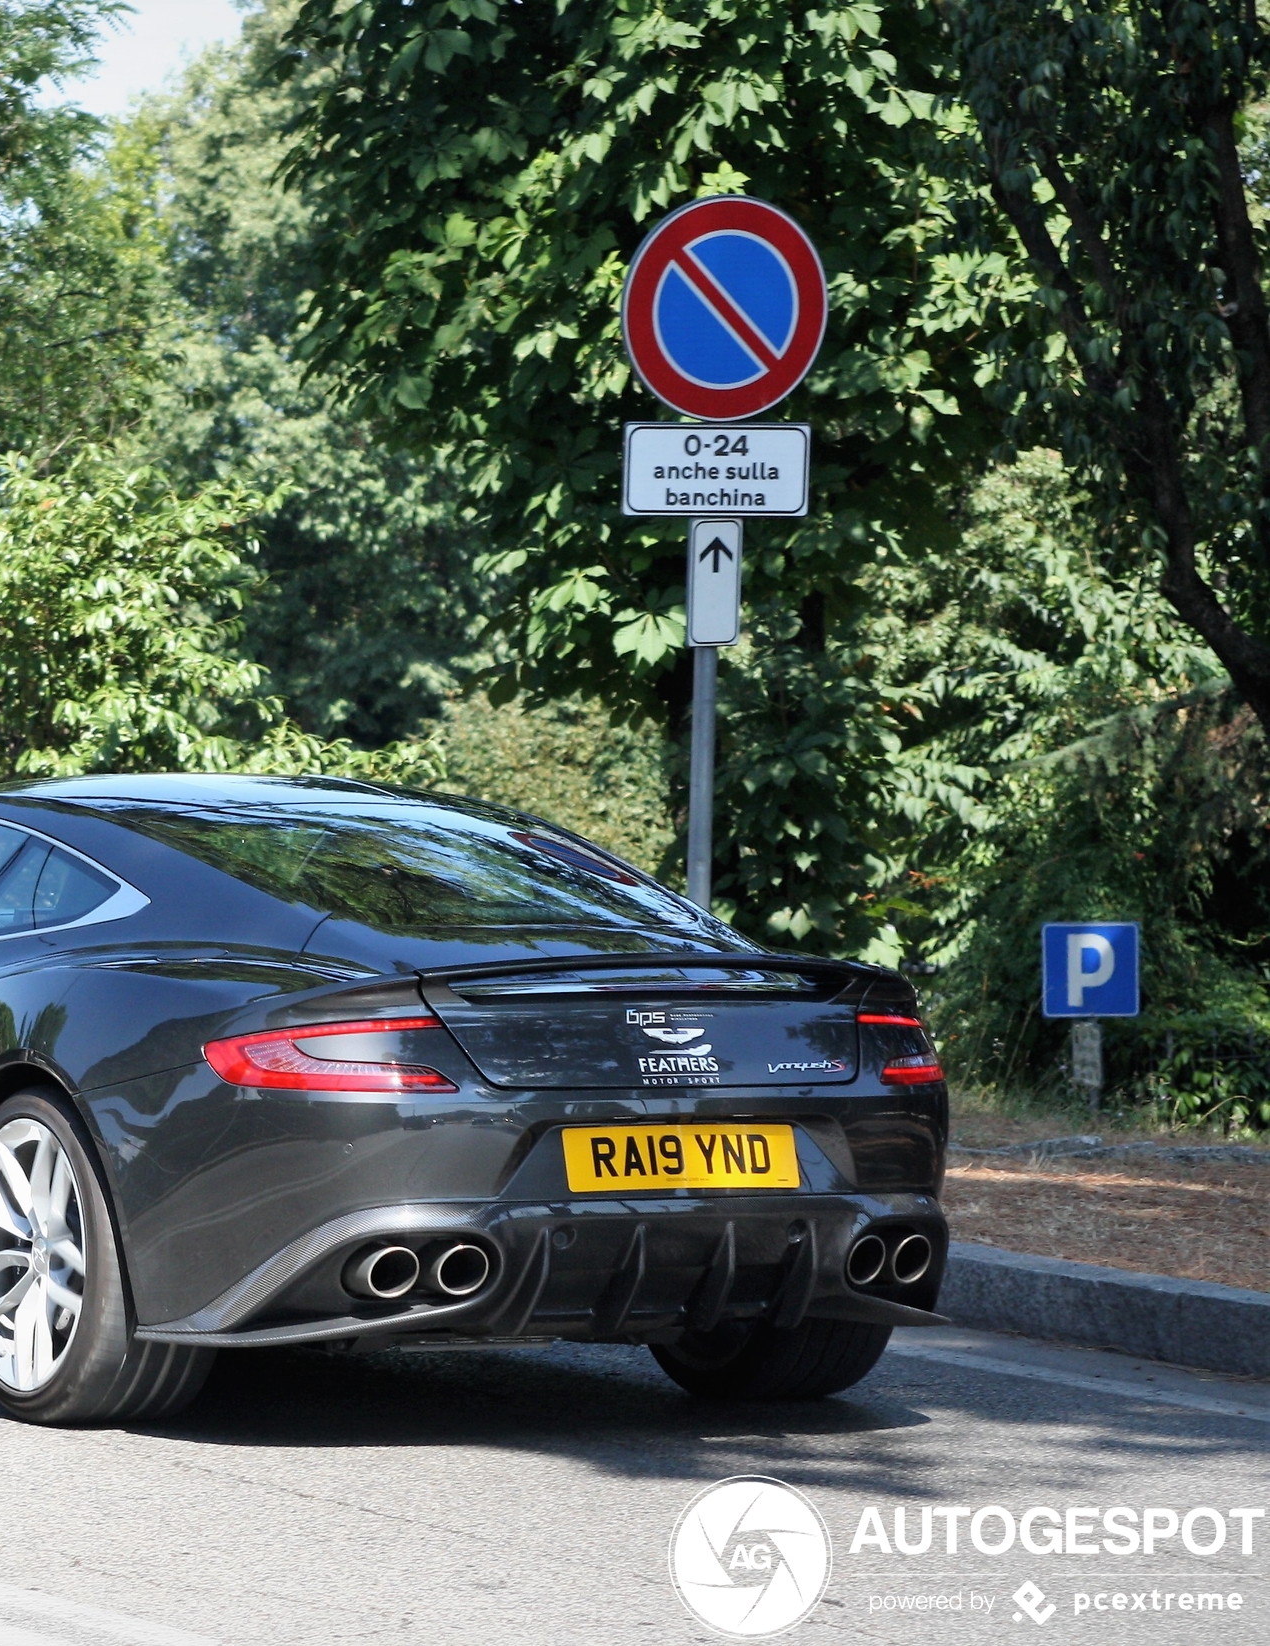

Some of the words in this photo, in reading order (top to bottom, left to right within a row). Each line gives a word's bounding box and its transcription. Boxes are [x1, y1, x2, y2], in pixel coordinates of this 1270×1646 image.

[683, 434, 749, 457] 0-24
[653, 462, 720, 480] anche
[725, 462, 779, 480] sulla
[665, 488, 766, 506] banchina
[1066, 933, 1115, 1007] P
[638, 1057, 719, 1073] FEATHERS
[642, 1077, 679, 1086] MOTOR
[688, 1077, 721, 1086] SPORT
[590, 1134, 685, 1178] RA19
[694, 1133, 771, 1175] YND
